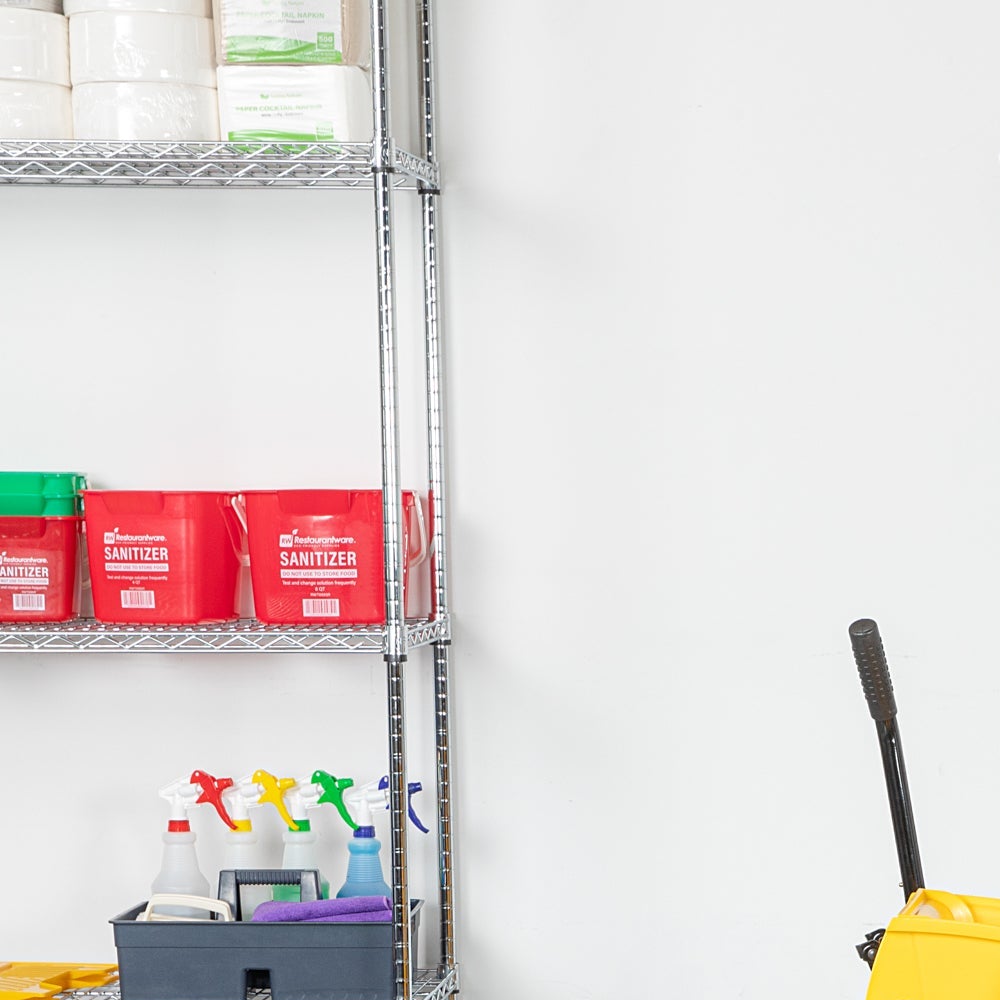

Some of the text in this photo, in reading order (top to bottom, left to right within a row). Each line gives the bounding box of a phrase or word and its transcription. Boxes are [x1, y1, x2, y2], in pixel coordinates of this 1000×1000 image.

[104, 546, 169, 561] SANITIZER
[280, 551, 357, 567] SANITIZER
[0, 566, 49, 577] ANITIZER
